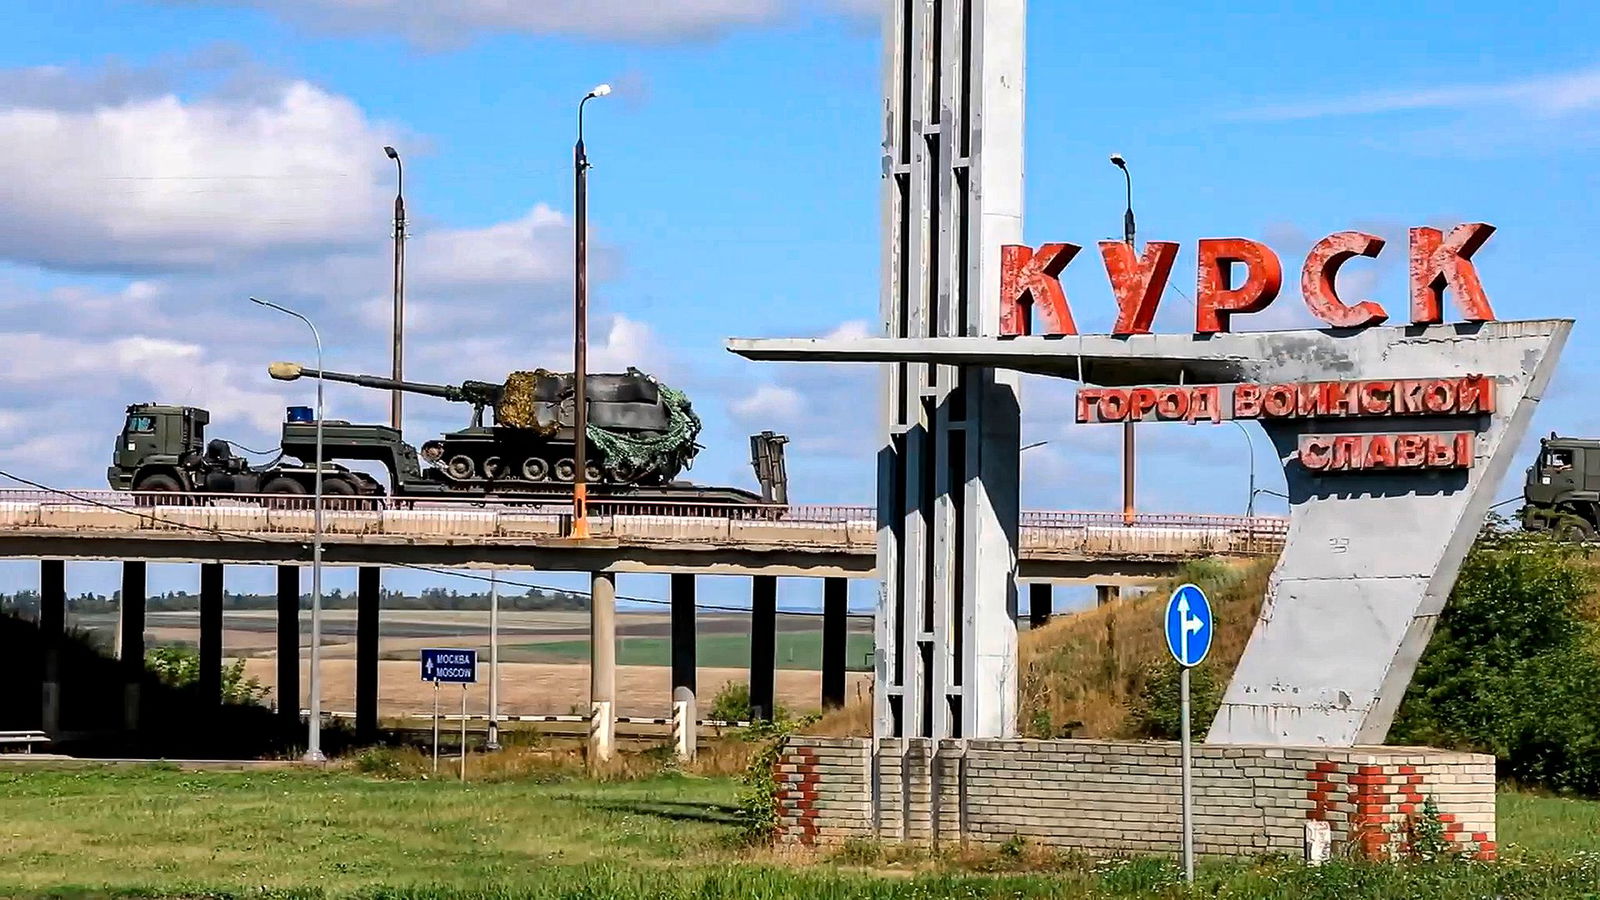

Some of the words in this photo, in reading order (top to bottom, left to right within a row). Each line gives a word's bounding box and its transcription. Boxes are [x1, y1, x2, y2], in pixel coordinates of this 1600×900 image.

[1000, 222, 1496, 336] КУРСК
[1077, 386, 1221, 424] ГОРОД
[1234, 374, 1492, 418] ВОИНСКОЙ
[1299, 433, 1472, 470] СЛАВЫ
[436, 654, 470, 663] МОСКВА
[436, 667, 472, 677] MOSCOW
